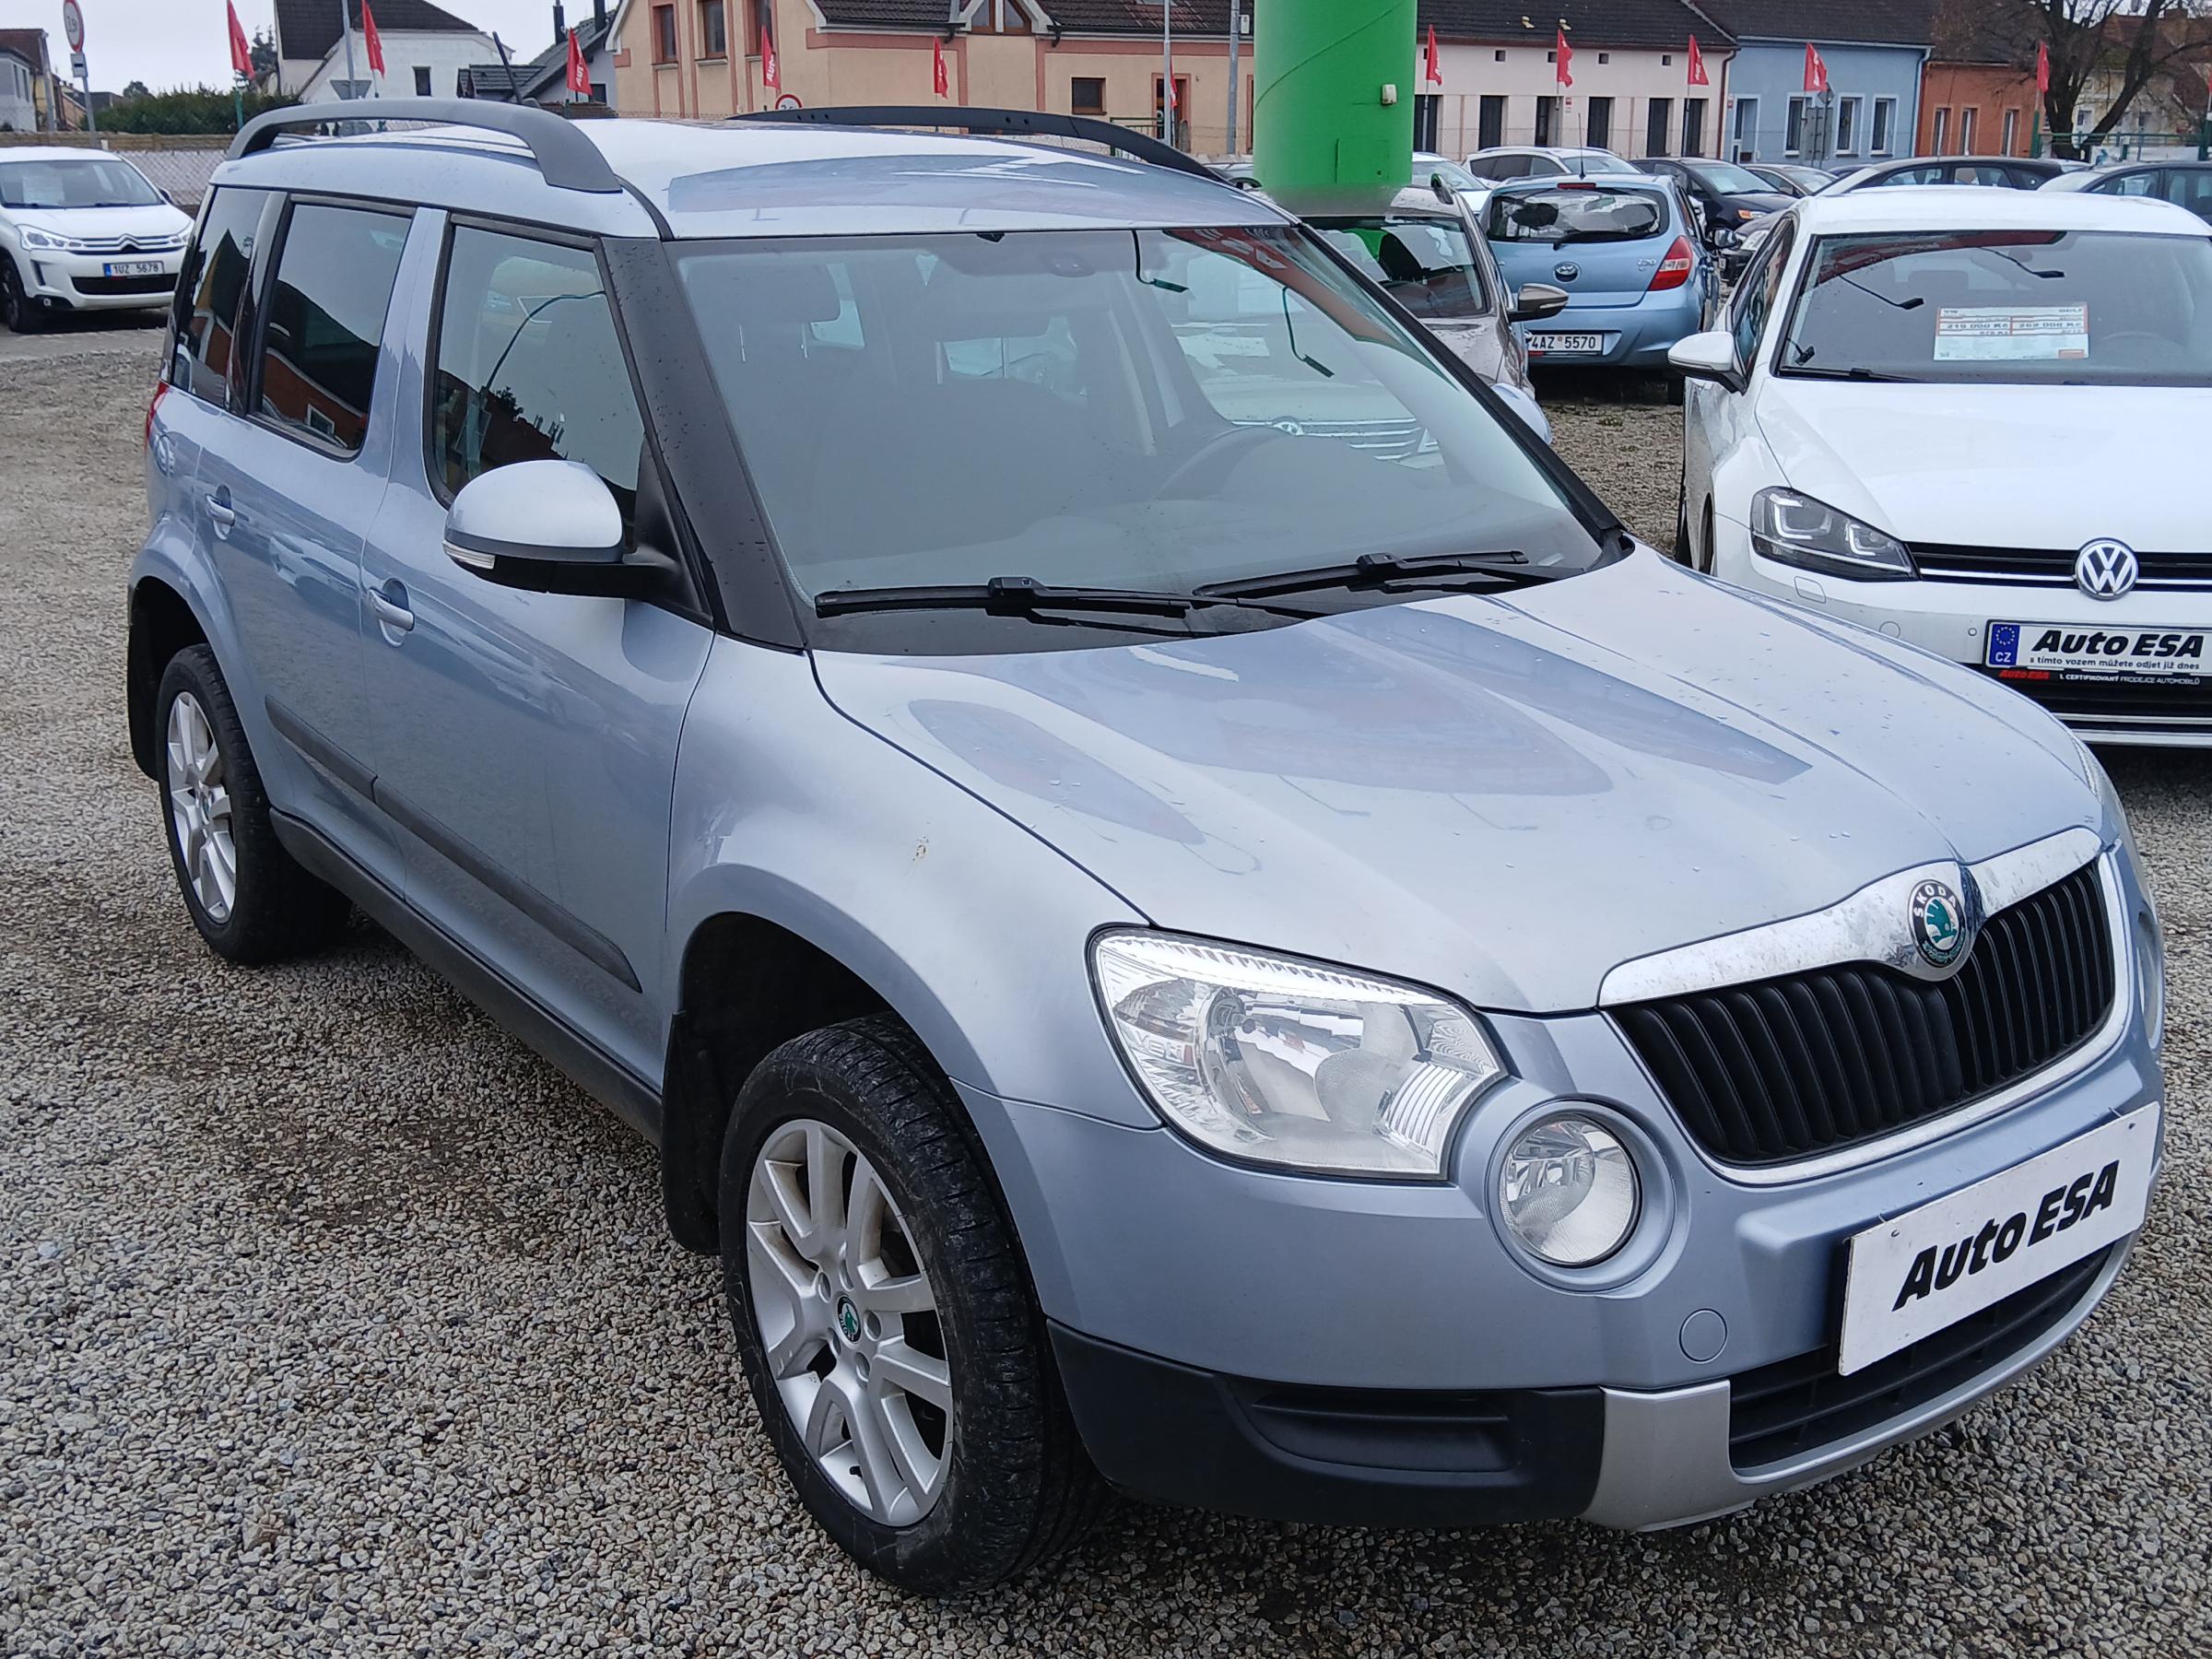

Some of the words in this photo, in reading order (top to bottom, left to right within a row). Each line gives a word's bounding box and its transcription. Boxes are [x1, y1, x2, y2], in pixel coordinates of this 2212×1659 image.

[1531, 336, 1555, 349] 4AZ
[1564, 336, 1596, 349] 5570
[2131, 634, 2204, 658] ESA
[1995, 652, 2011, 663] CZ
[2038, 656, 2063, 665] tímto
[2065, 658, 2097, 666] vozem
[2136, 661, 2160, 669] odjet
[2177, 662, 2200, 670] dnes
[2027, 1159, 2120, 1247] ESA
